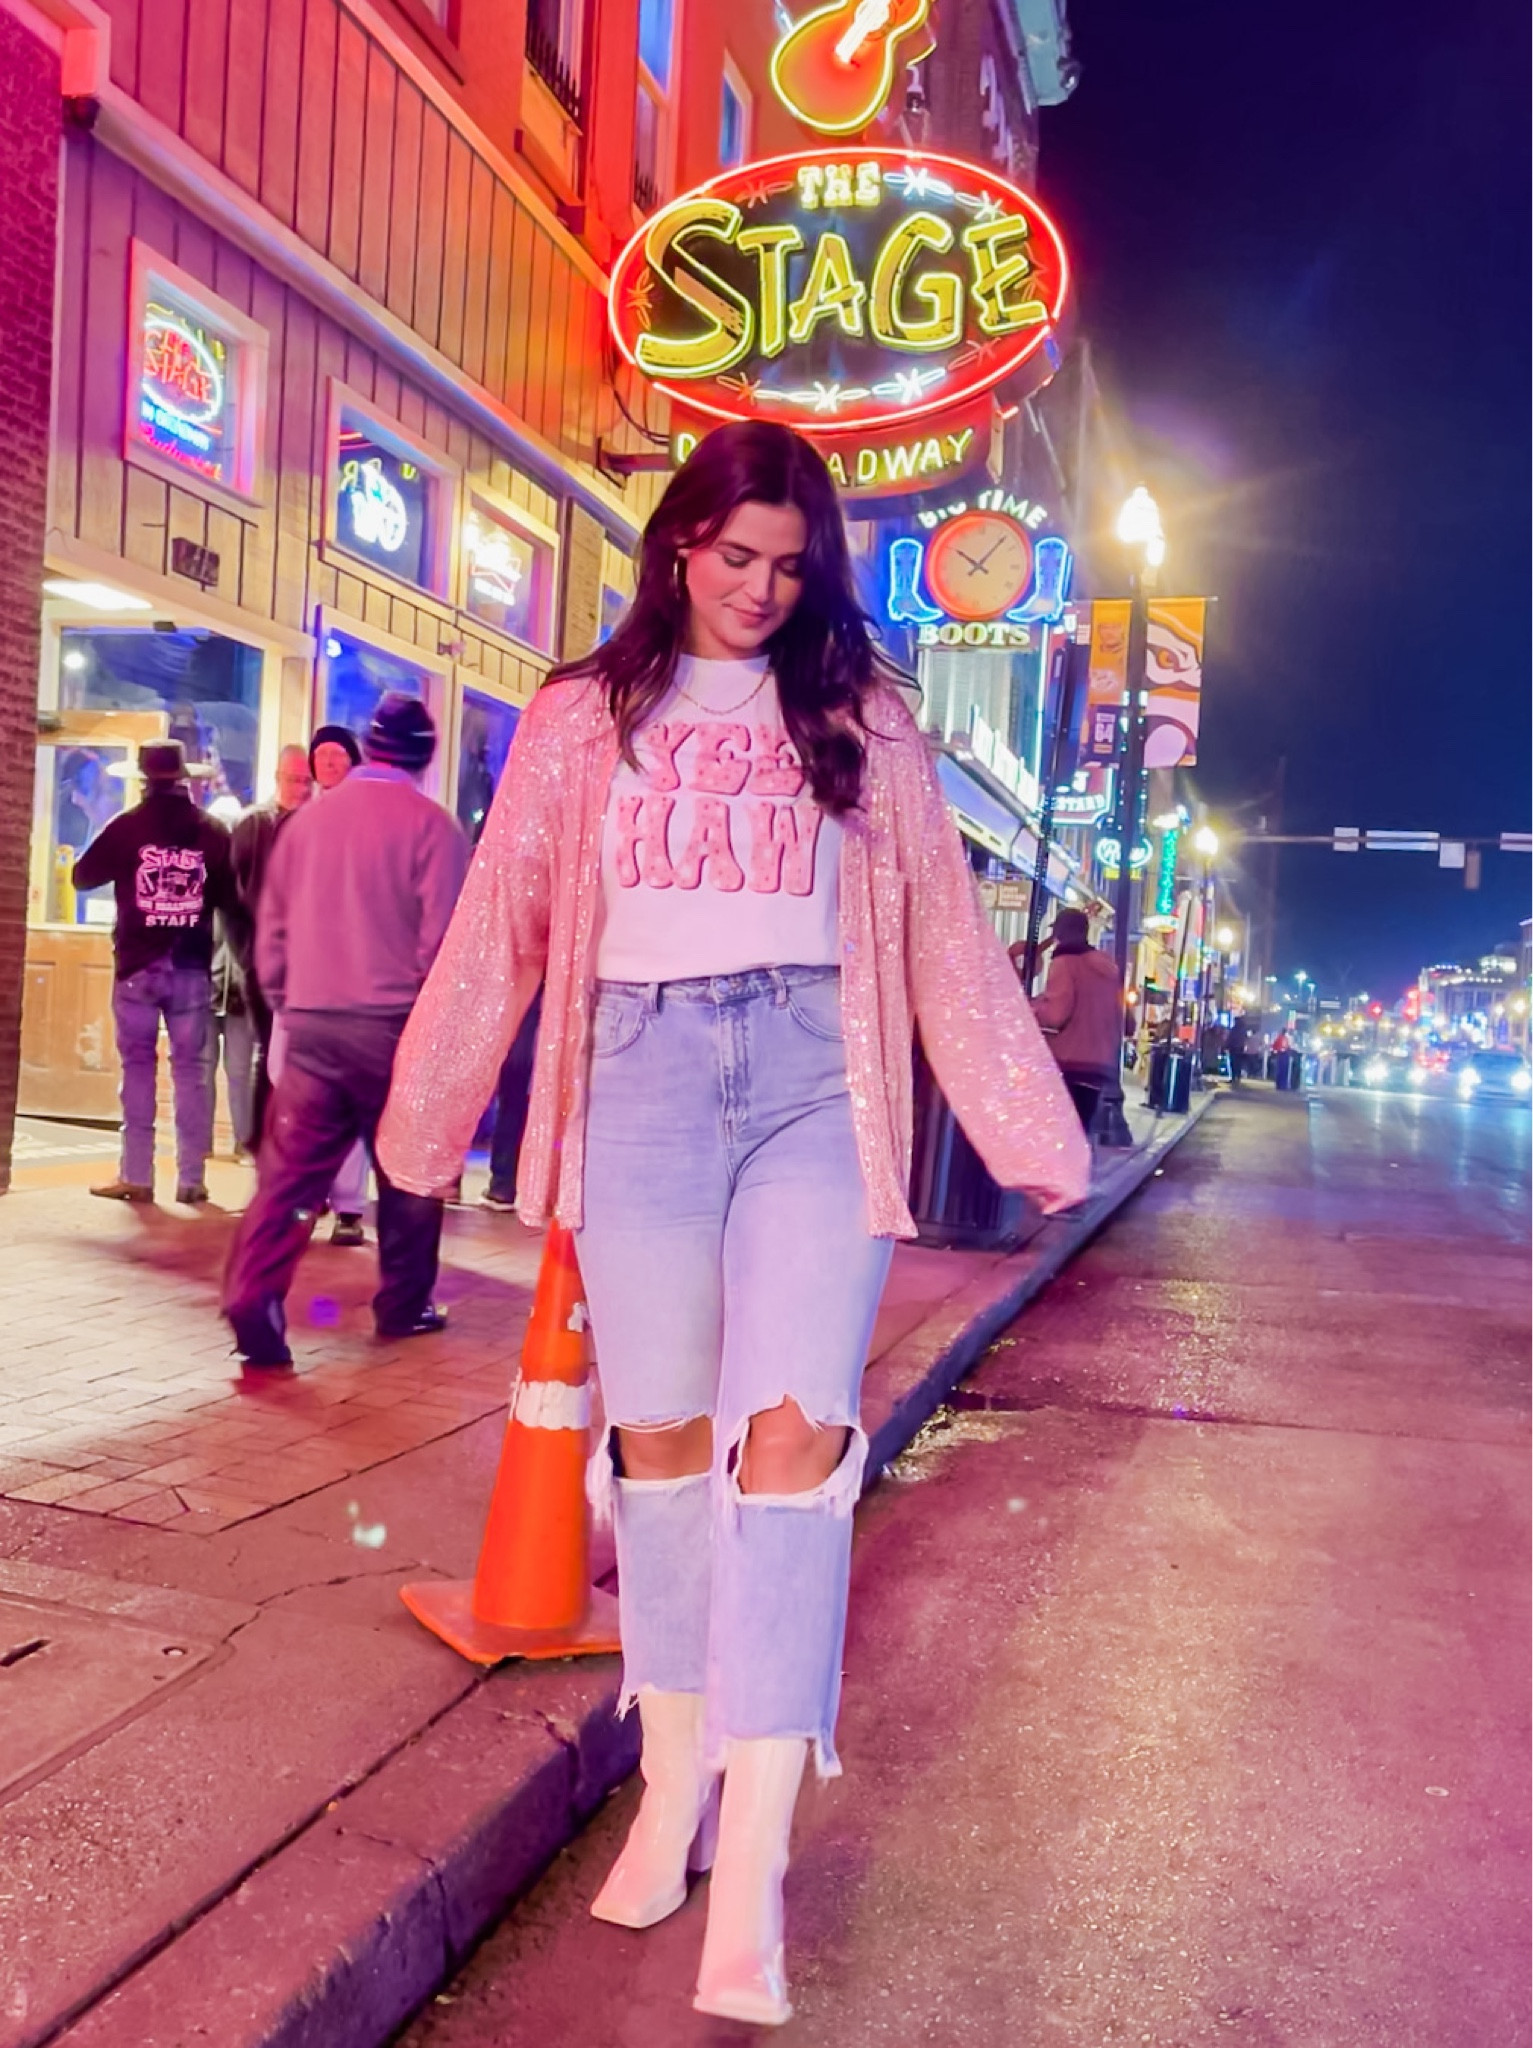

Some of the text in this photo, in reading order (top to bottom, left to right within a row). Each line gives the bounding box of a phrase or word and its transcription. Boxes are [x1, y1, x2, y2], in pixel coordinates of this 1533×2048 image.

[798, 163, 880, 208] THE
[636, 199, 1048, 378] STAGE
[828, 428, 975, 484] ADWAY
[978, 489, 1048, 529] TIME
[917, 623, 1031, 645] BOOTS
[646, 722, 806, 796] YEE
[616, 797, 824, 896] HAW
[146, 915, 199, 927] STAFF
